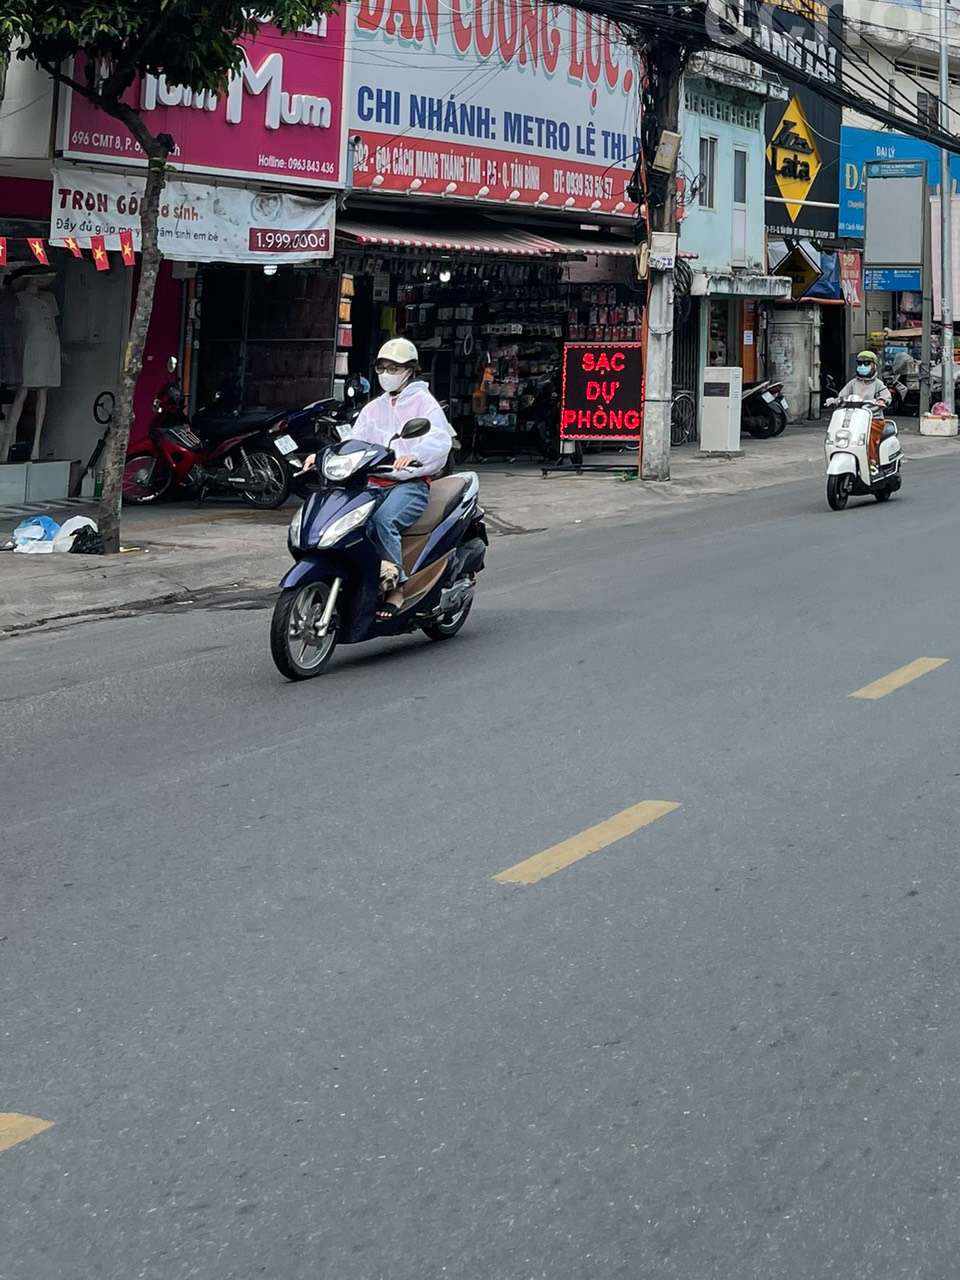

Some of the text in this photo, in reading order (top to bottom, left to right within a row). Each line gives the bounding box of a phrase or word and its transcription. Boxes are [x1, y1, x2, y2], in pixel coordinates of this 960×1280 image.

[357, 85, 400, 126] CHI
[410, 93, 496, 141] NHÁNH:
[503, 111, 570, 152] METRO
[576, 122, 596, 157] LÊ
[601, 130, 627, 168] THỊ
[72, 130, 90, 145] 696
[91, 132, 113, 149] CMT
[258, 154, 287, 169] Hotline:
[287, 158, 305, 171] 0963
[320, 161, 335, 175] 436
[392, 142, 415, 177] CÁCH
[415, 150, 439, 184] MẠNG
[440, 149, 465, 182] THÁNG
[465, 152, 482, 184] TÁM
[511, 158, 525, 188] TÂN
[524, 160, 541, 191] BÌNH
[566, 170, 583, 197] 0939
[58, 188, 109, 217] TRỌN
[173, 203, 199, 221] sinh
[582, 352, 625, 375] SẠC
[586, 381, 620, 404] DỰ
[563, 405, 640, 429] PHÒNG
